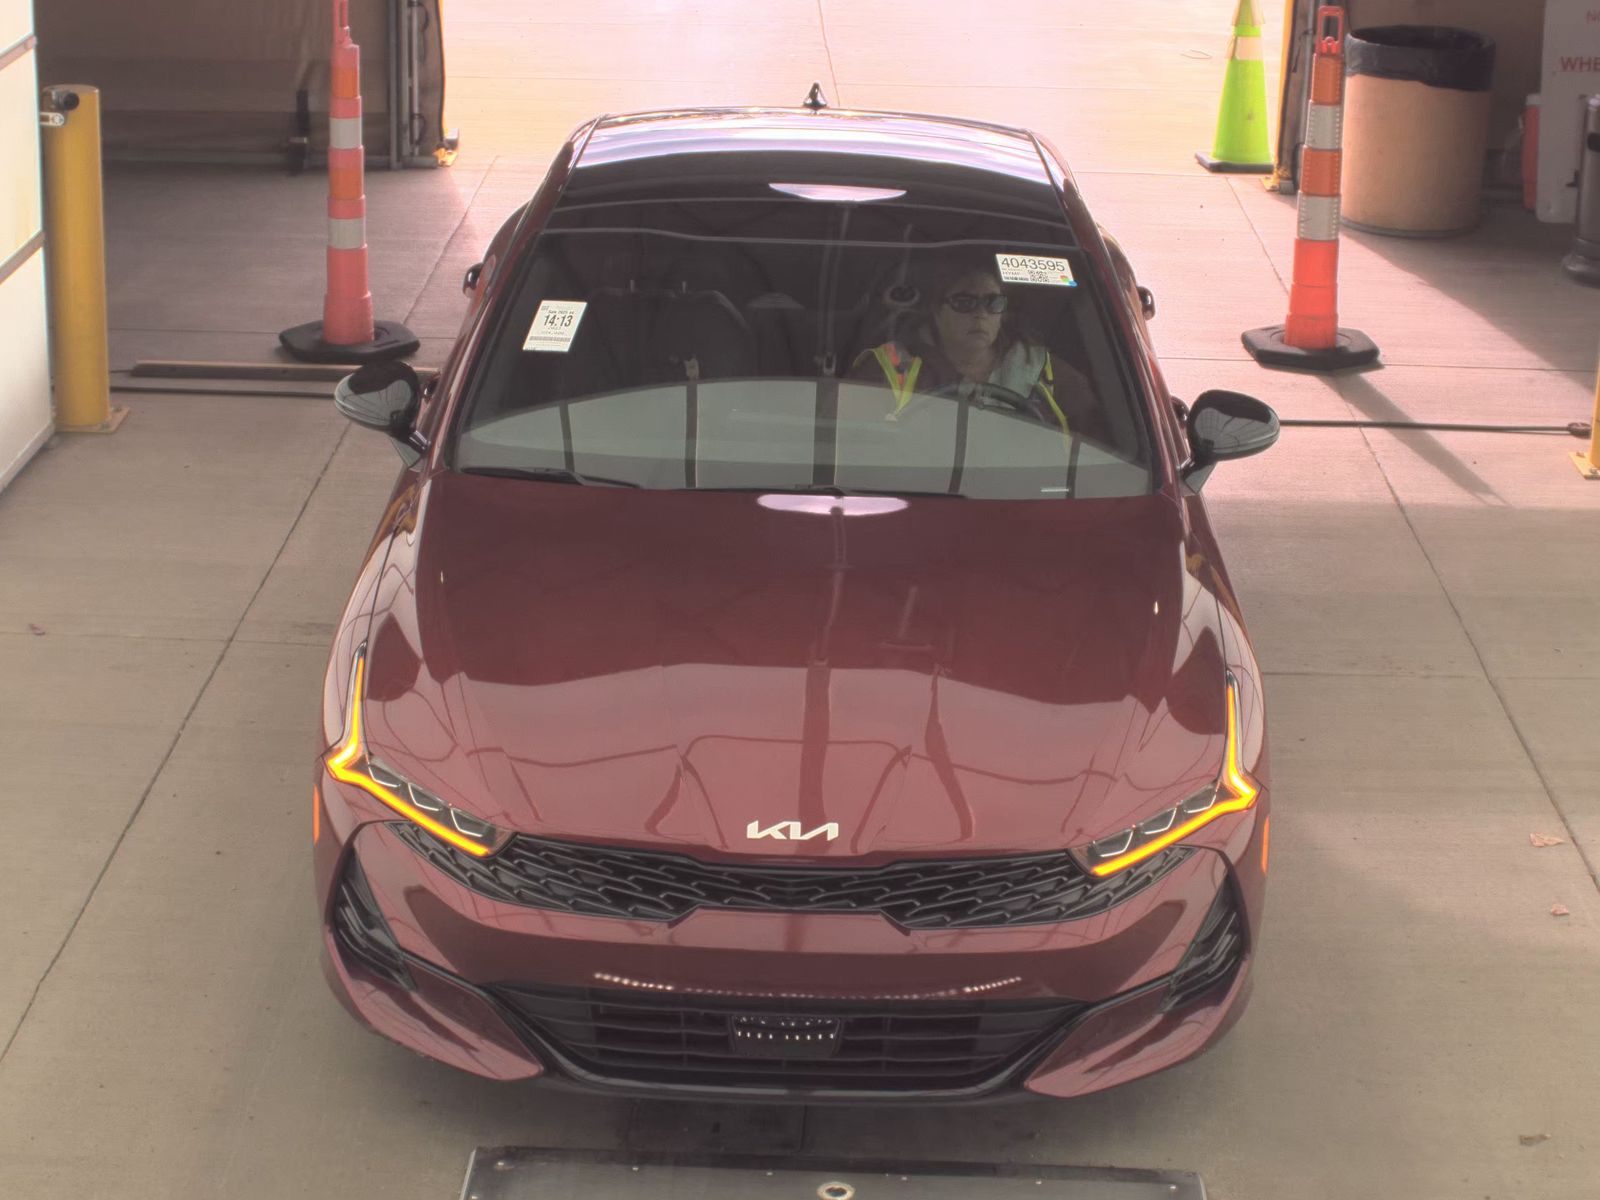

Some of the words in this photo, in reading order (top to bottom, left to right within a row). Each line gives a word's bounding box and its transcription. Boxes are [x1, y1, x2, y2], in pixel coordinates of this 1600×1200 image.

[1001, 257, 1065, 272] 4043595
[544, 314, 573, 327] 14:13
[747, 820, 839, 841] KIA
